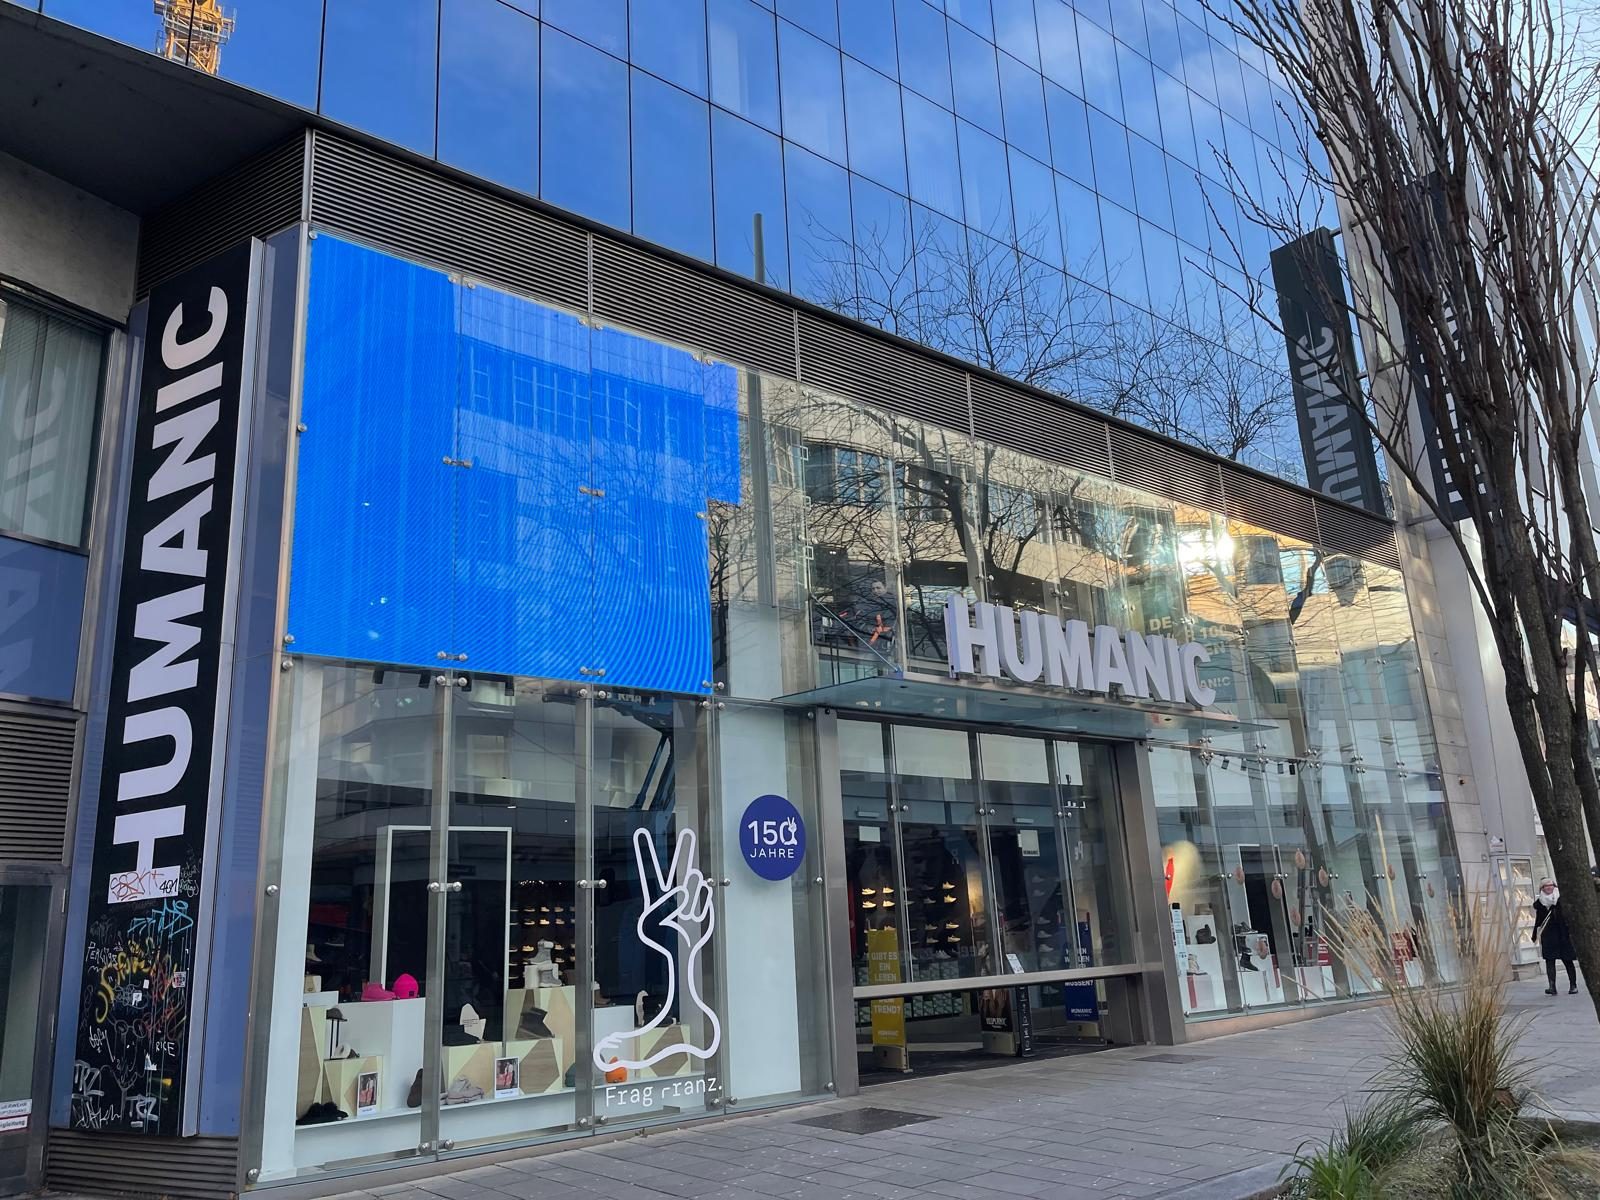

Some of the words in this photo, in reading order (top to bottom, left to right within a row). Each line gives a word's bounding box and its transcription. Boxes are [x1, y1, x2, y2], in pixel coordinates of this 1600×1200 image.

[107, 286, 229, 904] HUMANIC
[945, 594, 1217, 708] HUMANIC
[1199, 676, 1231, 689] ANIC
[748, 817, 797, 846] 150
[749, 848, 795, 859] JAHRE
[874, 1005, 901, 1014] TREND?
[605, 1086, 654, 1108] Frag
